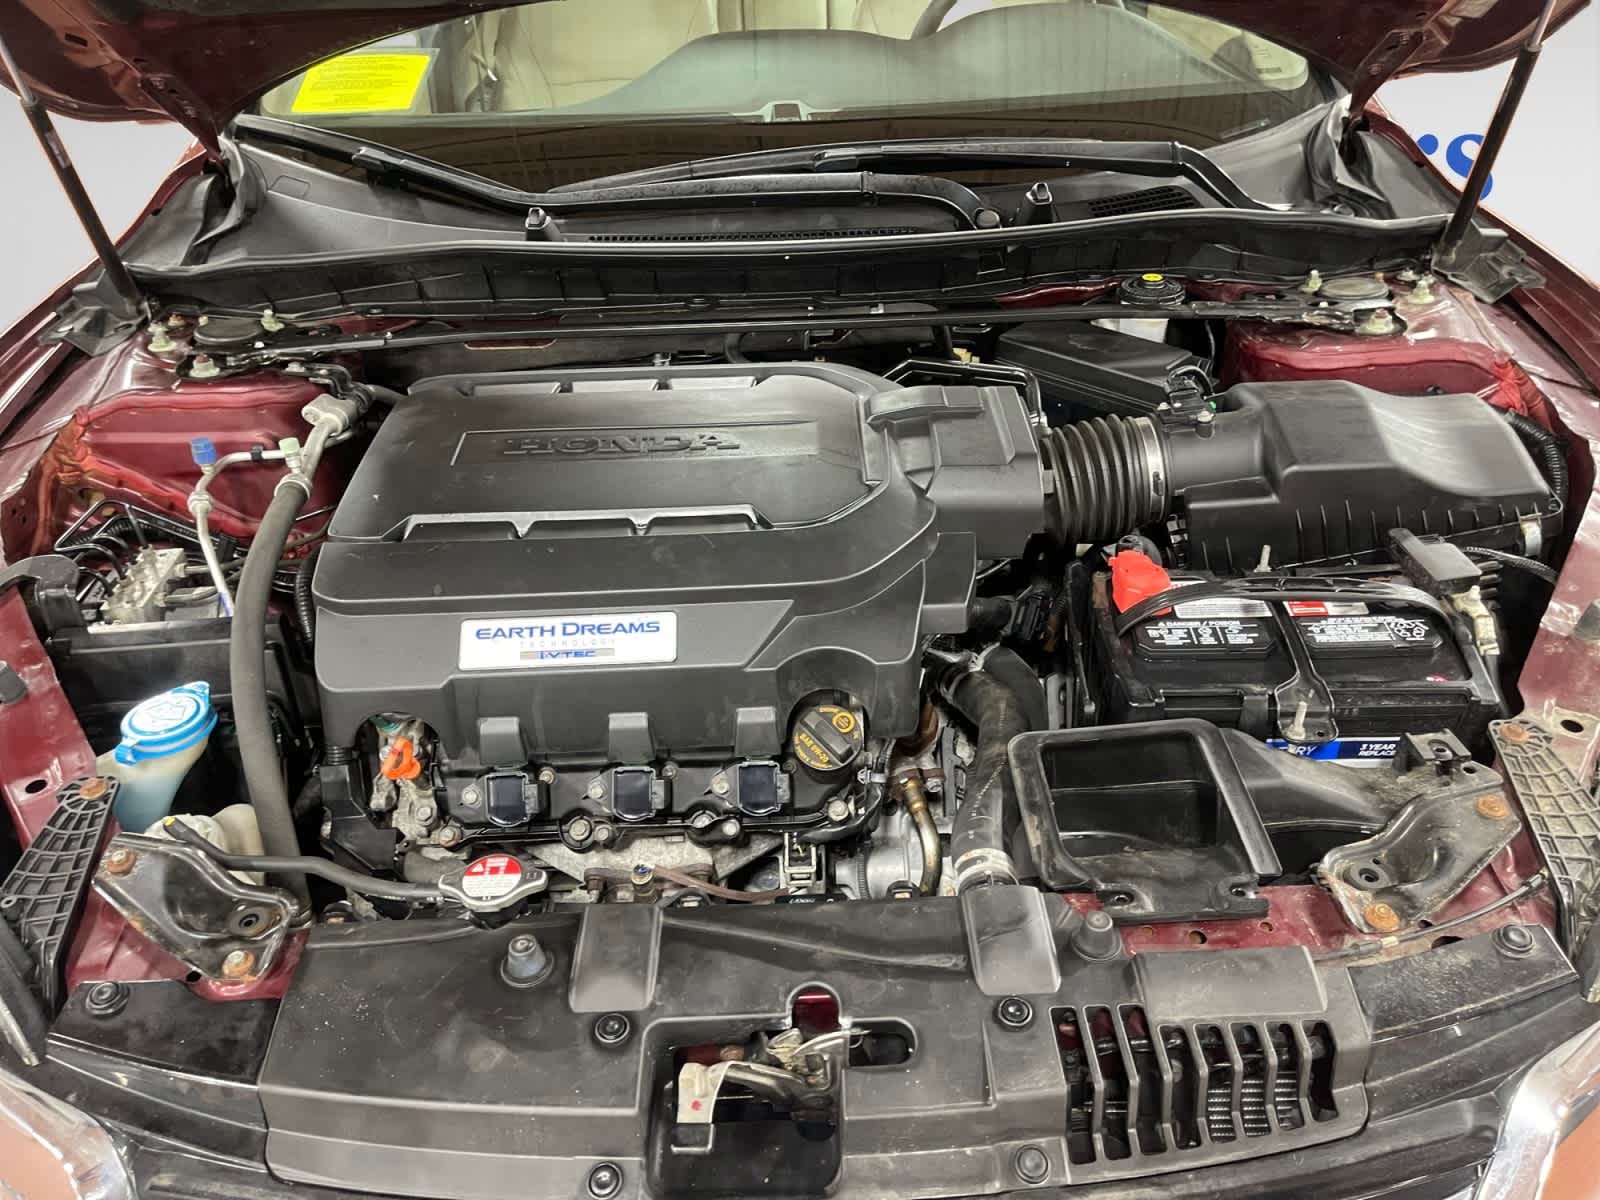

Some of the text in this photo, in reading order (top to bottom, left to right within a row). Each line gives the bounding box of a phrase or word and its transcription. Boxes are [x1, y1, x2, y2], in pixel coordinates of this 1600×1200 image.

[503, 433, 741, 455] HONDA
[475, 620, 661, 641] EARTH DREAMS
[1359, 743, 1397, 751] 3 YEAR
